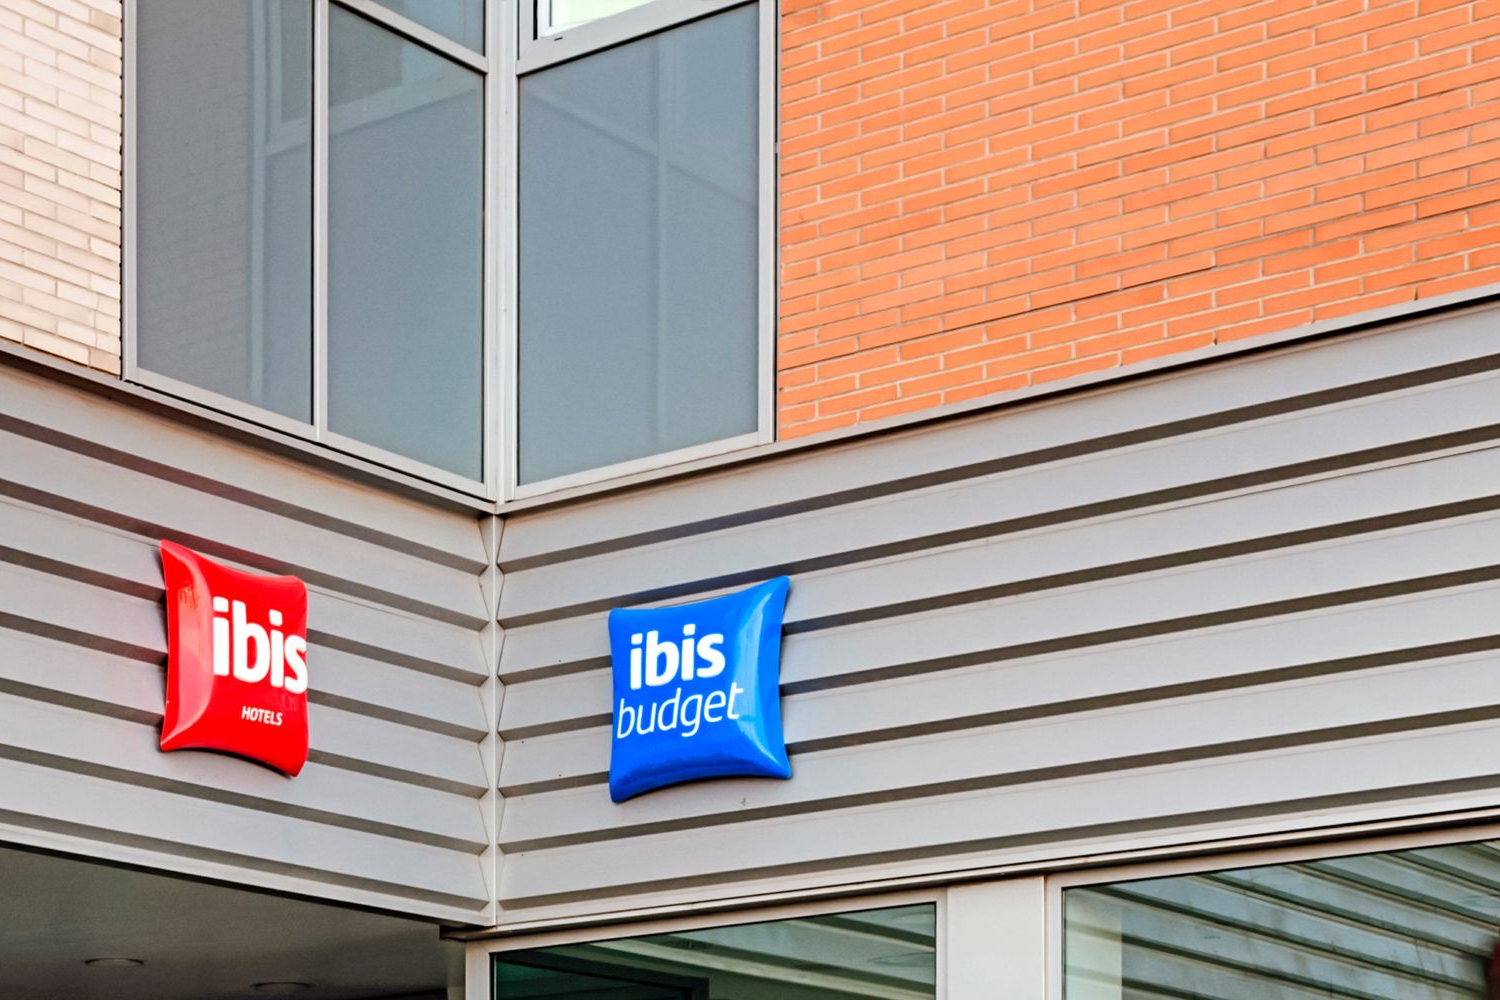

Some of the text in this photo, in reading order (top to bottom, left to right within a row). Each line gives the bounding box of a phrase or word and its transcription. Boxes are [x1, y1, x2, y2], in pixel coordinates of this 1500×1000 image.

[212, 596, 308, 694] ibis
[630, 623, 726, 690] ibis
[241, 705, 283, 726] HOTELS
[616, 682, 744, 738] budget
